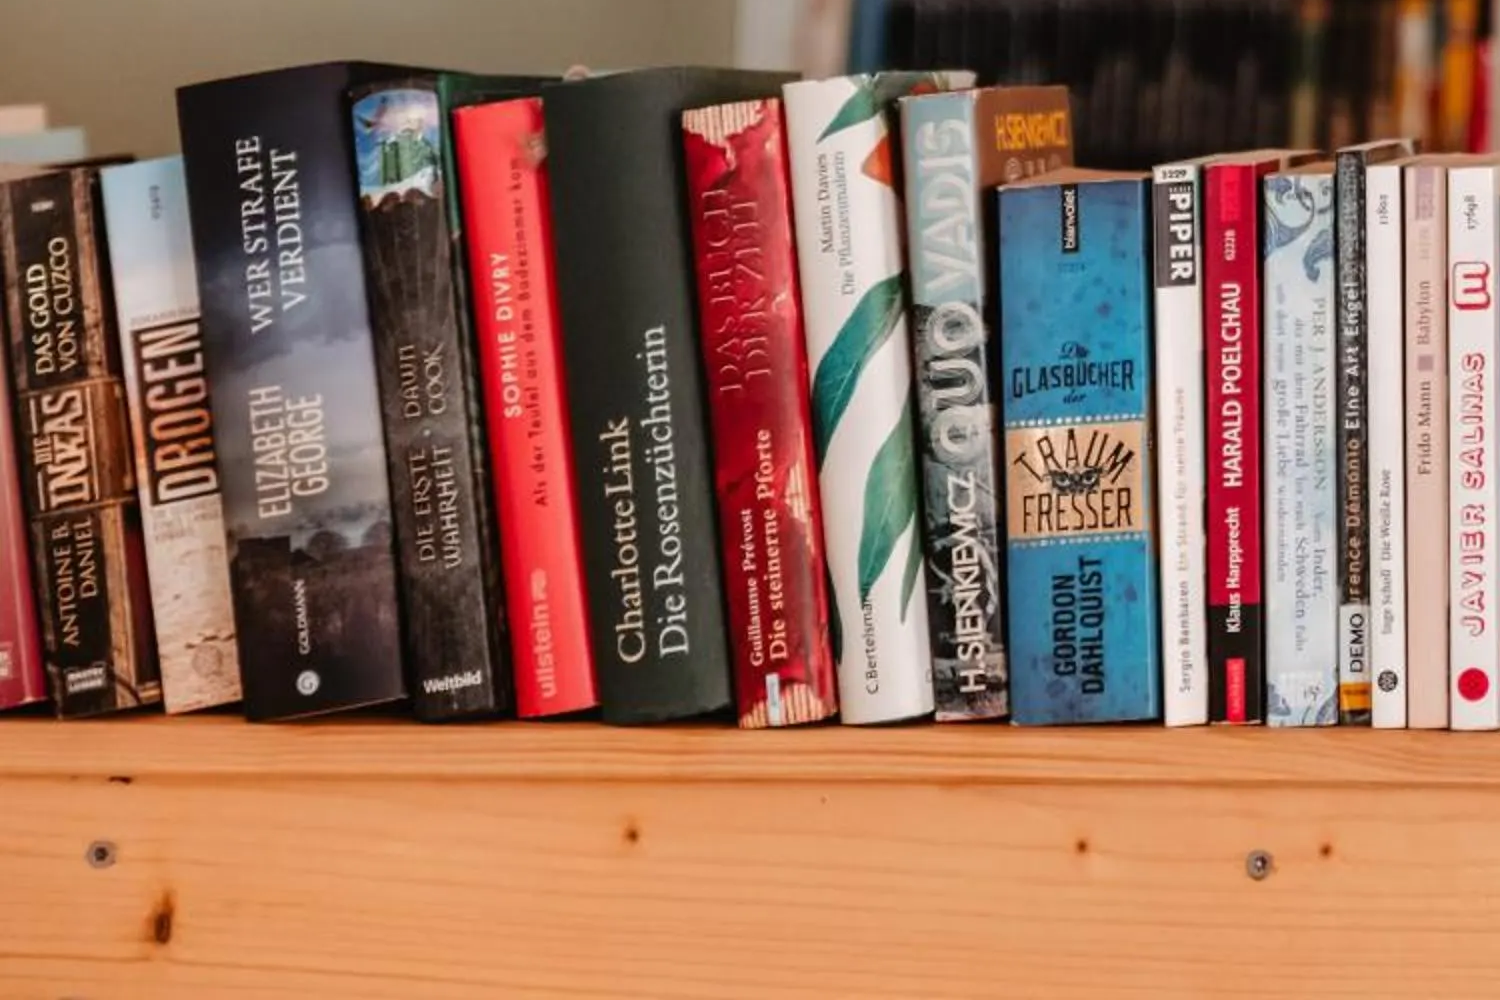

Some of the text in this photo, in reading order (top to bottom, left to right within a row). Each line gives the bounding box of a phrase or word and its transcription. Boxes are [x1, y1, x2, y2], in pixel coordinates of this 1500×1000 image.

[236, 135, 274, 335] WER STRAFE
[269, 148, 308, 312] VERDIENT
[815, 153, 835, 253] Martin Davies
[1169, 193, 1193, 281] PIPER
[26, 263, 55, 376] DAS GOLD
[48, 236, 78, 372] VON CUZCO
[520, 309, 536, 343] dem
[841, 270, 856, 296] Die
[915, 118, 992, 463] QUO VADIS
[1343, 281, 1362, 337] Engel
[1416, 280, 1434, 345] Babylon
[398, 344, 422, 418] DAWN
[424, 341, 446, 414] COOK
[490, 253, 523, 419] SOPHIE DIVRY
[524, 350, 538, 379] aus
[1220, 283, 1242, 394] POELCHAU
[1344, 345, 1360, 377] Art
[138, 319, 219, 500] DROGEN
[526, 386, 545, 439] Teufel
[1062, 388, 1088, 404] der
[1417, 380, 1432, 427] Mann
[33, 432, 53, 465] DIE
[41, 390, 92, 508] INKAS
[249, 384, 293, 520] ELIZABETH
[286, 392, 331, 499] GEORGE
[529, 447, 545, 473] der
[756, 429, 777, 501] Pforte
[1013, 428, 1136, 484] TRAUM
[1222, 400, 1243, 487] HARALD
[1275, 433, 1292, 478] Liebe
[1311, 296, 1329, 597] PER ANDERSSON Inder,
[1416, 432, 1432, 475] Frido
[410, 447, 436, 562] DIE ERSTE
[431, 446, 464, 570] WAHRHEIT
[534, 481, 549, 507] Als
[635, 325, 689, 659] Die Rosenzüchterin
[1022, 487, 1134, 533] FRESSER
[1294, 403, 1310, 618] Fahrrad Schweden
[1459, 352, 1486, 637] JAVIER SALINAS
[74, 515, 98, 599] DANIEL
[600, 415, 646, 664] Charlotte Link
[762, 509, 784, 612] steinerne
[1225, 506, 1244, 633] Klaus Harpprecht
[53, 544, 80, 647] ANTOINE
[740, 507, 764, 667] Guillaume Prévost
[1052, 574, 1077, 677] GORDON
[1078, 554, 1105, 695] DAHLQUIST
[423, 669, 482, 694] Weltbild
[530, 600, 557, 699] ullstein
[769, 622, 789, 661] Die
[1178, 651, 1193, 693] Sergio
[1349, 612, 1365, 674] DEMO
